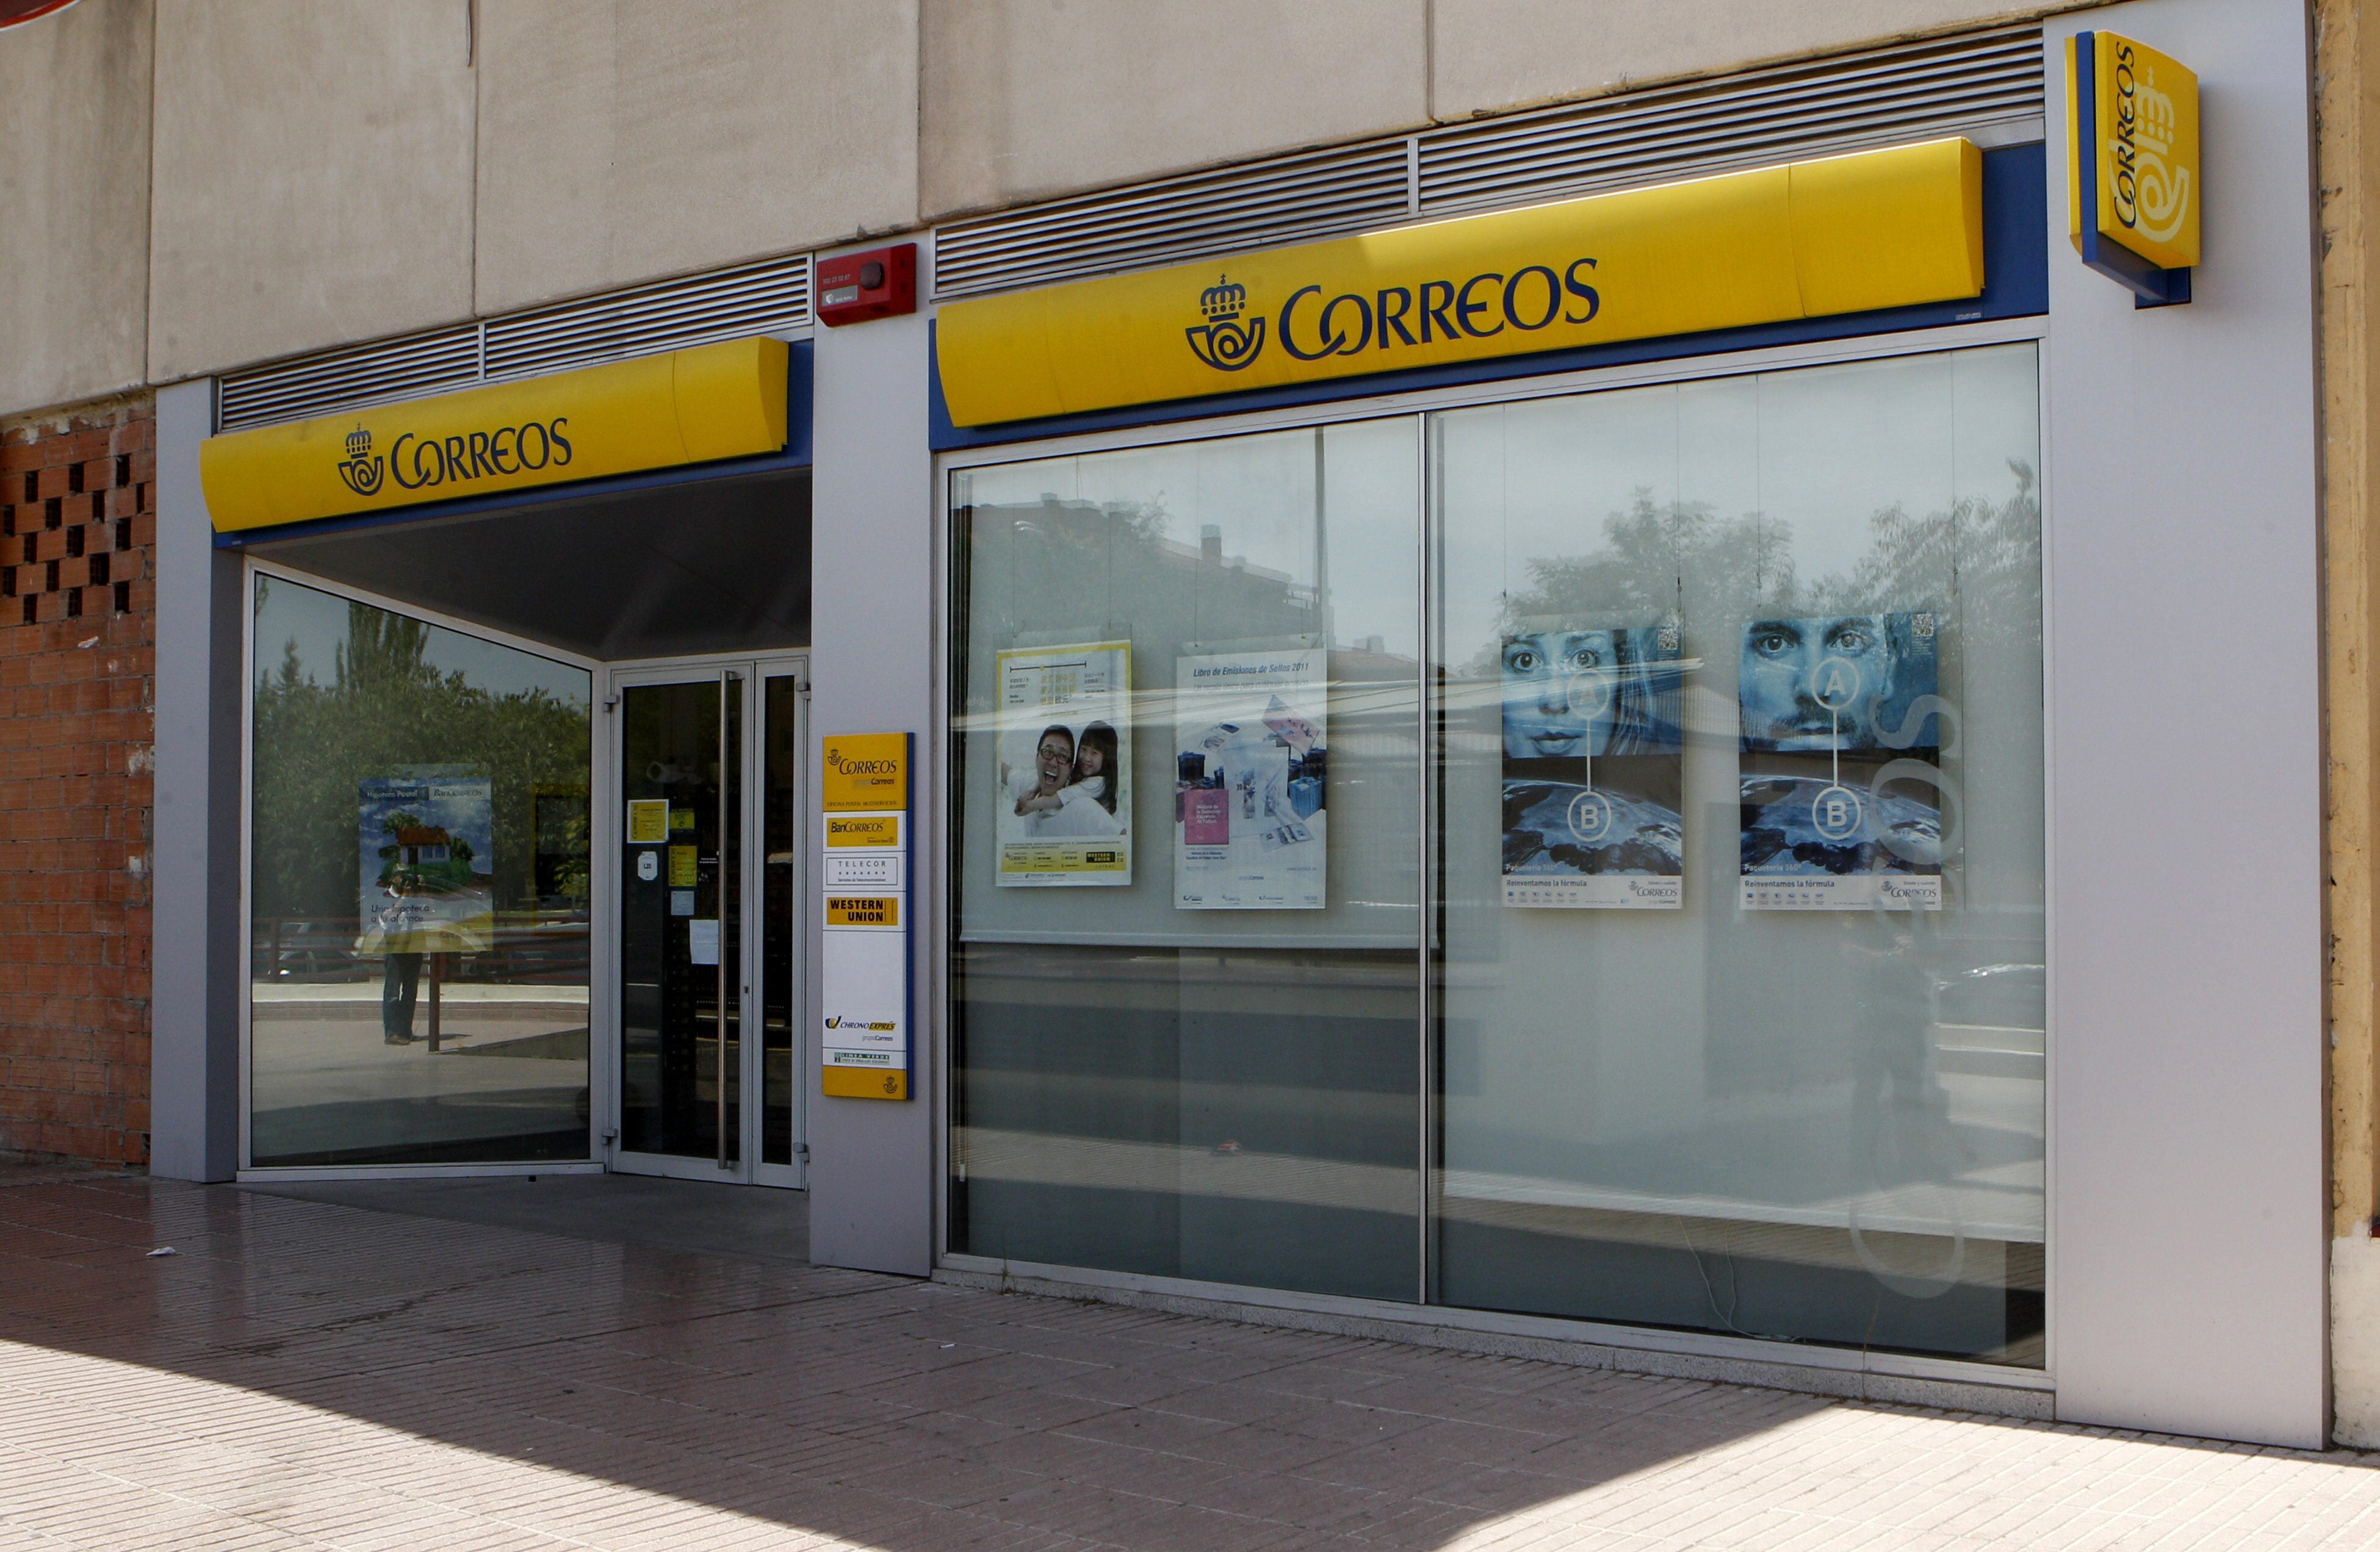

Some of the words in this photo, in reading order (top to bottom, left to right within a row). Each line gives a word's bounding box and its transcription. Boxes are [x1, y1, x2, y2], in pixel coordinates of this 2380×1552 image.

[2114, 41, 2136, 229] CORREOS
[1279, 257, 1600, 361] CORREOS
[391, 417, 572, 489] CORREOS
[1193, 669, 1210, 677] Libro
[1222, 666, 1257, 675] Emisiones
[1269, 663, 1290, 673] Sellos
[1292, 663, 1309, 671] 2011
[1824, 670, 1847, 696] A
[839, 758, 897, 775] CORREOS
[1581, 805, 1599, 830] B
[1826, 801, 1847, 827] B
[831, 821, 884, 833] BanCORREOS
[1637, 887, 1678, 897] CORREOS
[830, 900, 884, 910] WESTERN
[848, 911, 884, 922] UNION
